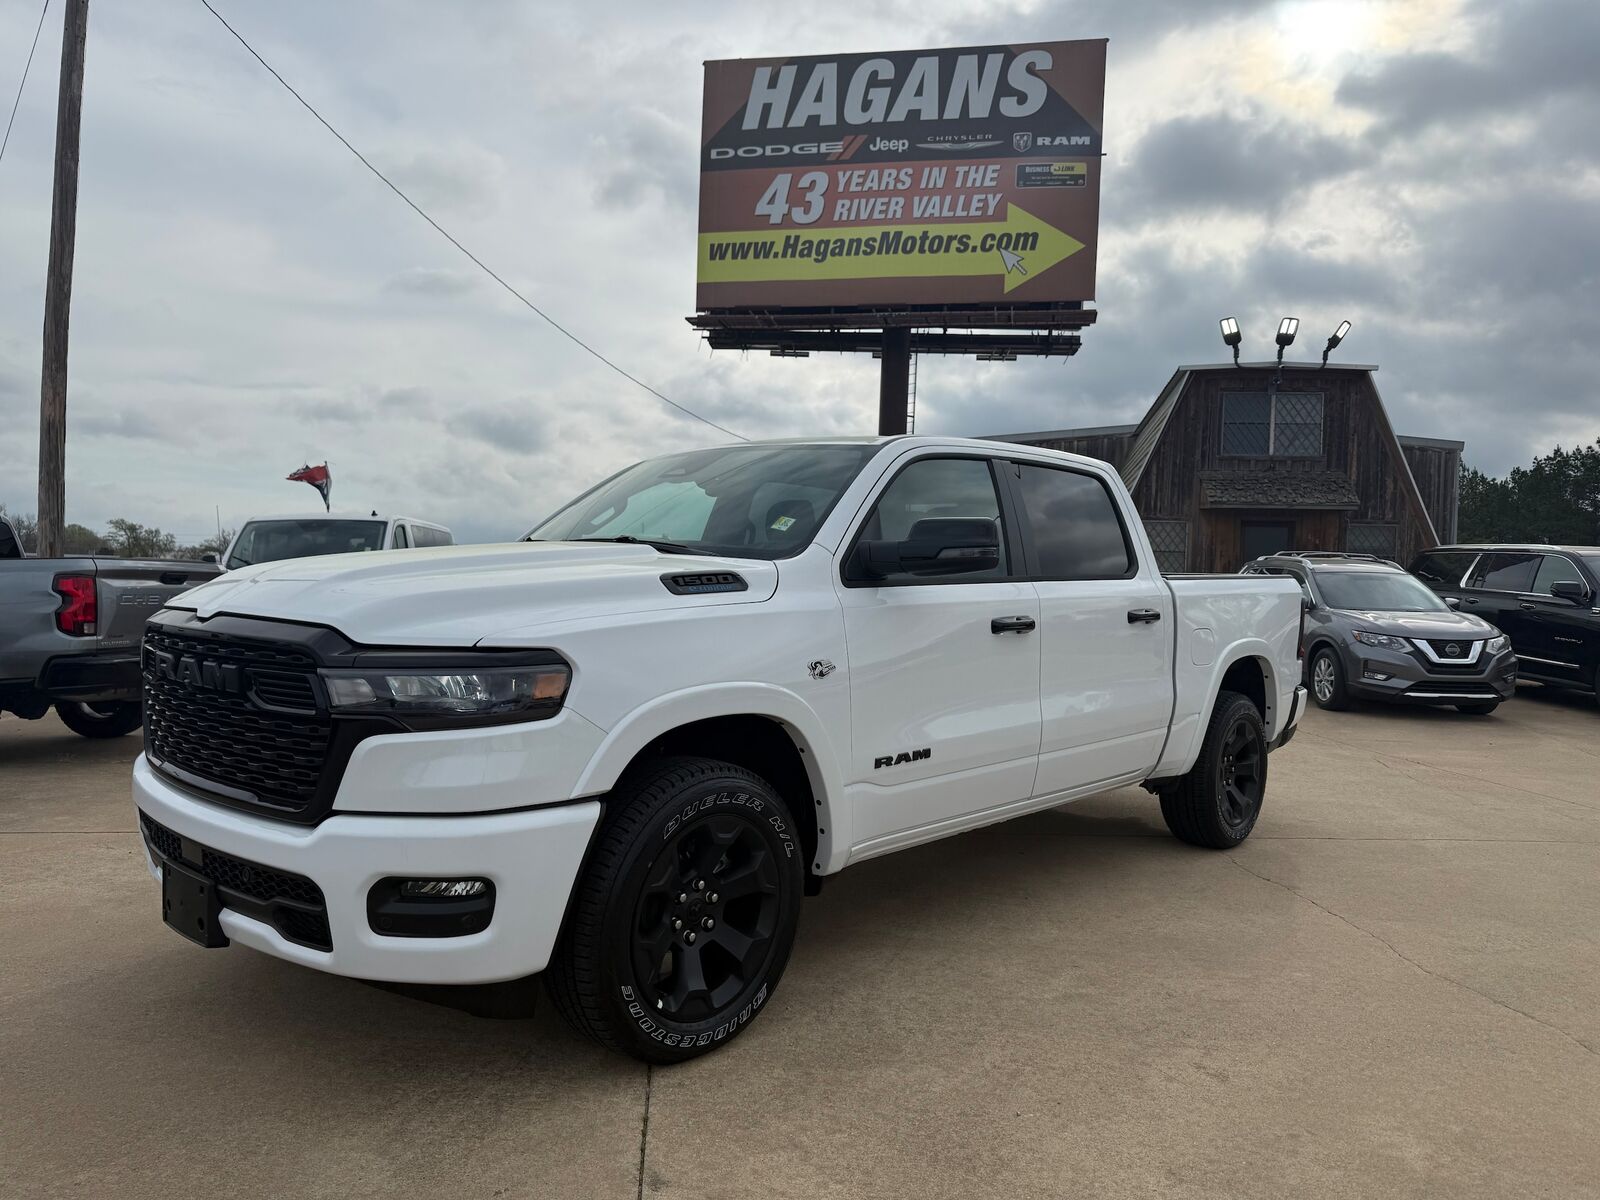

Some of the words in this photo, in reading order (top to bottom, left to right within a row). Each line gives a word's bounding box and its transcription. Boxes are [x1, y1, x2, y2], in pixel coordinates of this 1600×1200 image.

[742, 50, 1053, 130] HAGANS
[710, 141, 843, 159] DODGE
[869, 137, 909, 152] Jeep
[927, 134, 993, 142] CHRYSLER
[1036, 136, 1091, 146] RAM
[836, 167, 913, 193] YEARS
[919, 166, 948, 189] IN
[955, 164, 1001, 188] THE
[754, 171, 830, 226] 43
[833, 198, 904, 222] RIVER
[912, 193, 1003, 219] VALLEY
[709, 229, 1039, 264] www.HagansMotors.com
[676, 574, 735, 586] 1500
[155, 650, 240, 694] RAM
[873, 748, 932, 769] RAM
[664, 792, 765, 840] DUELER
[769, 816, 794, 858] H/L
[621, 982, 768, 1048] BRIDGESTONE
